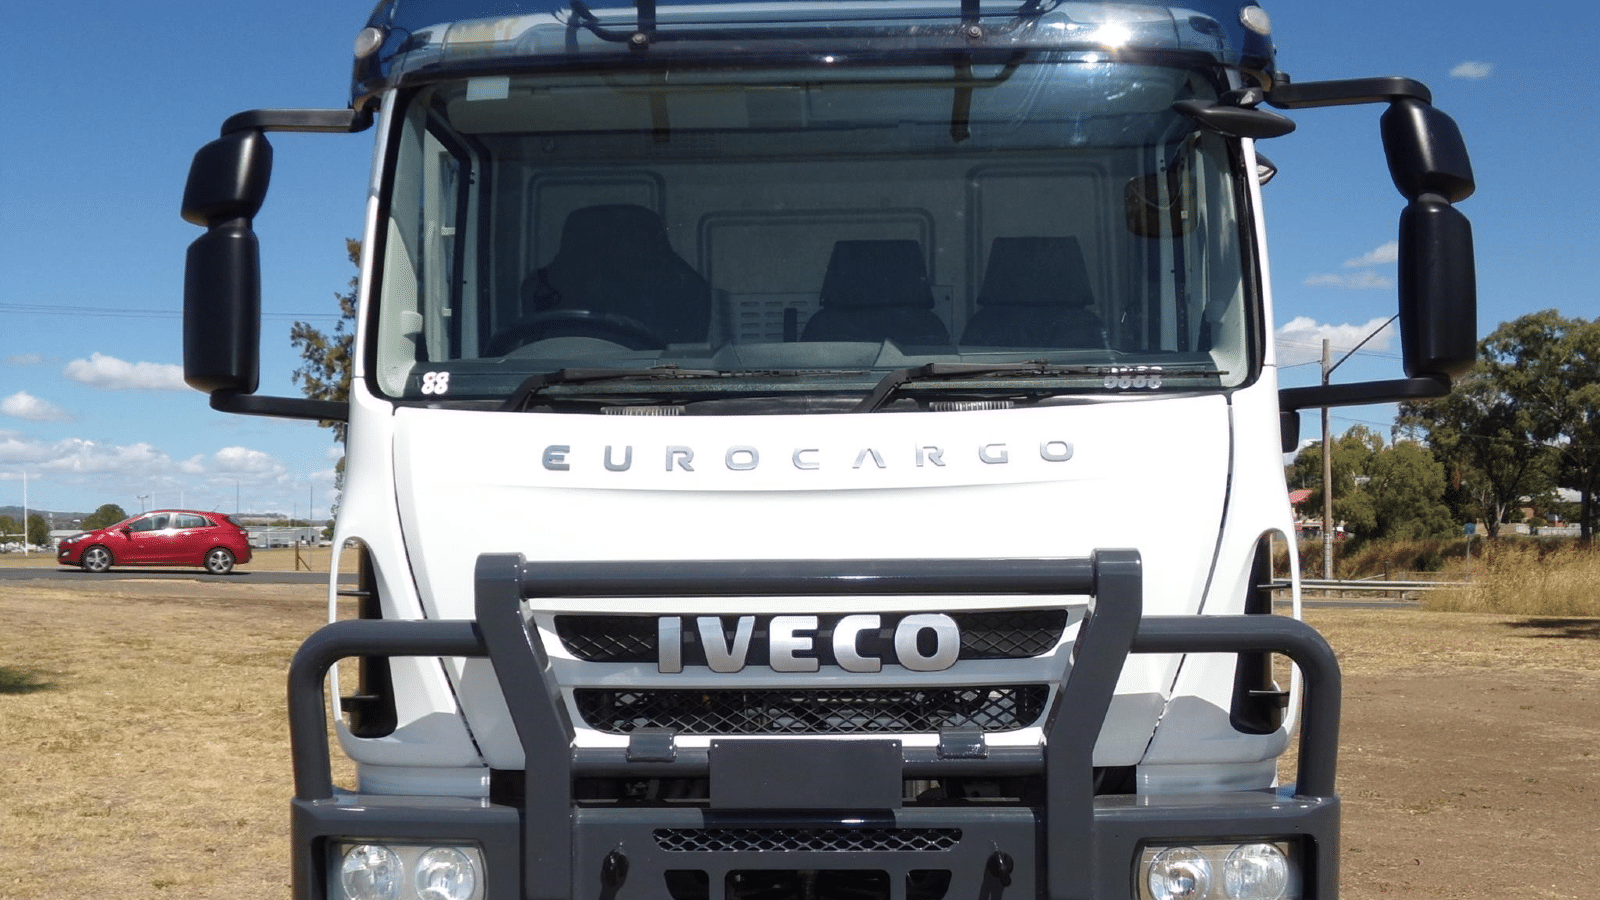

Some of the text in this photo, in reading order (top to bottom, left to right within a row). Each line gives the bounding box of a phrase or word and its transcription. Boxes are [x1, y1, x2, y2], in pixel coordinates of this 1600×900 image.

[421, 371, 449, 395] 88
[541, 440, 1074, 471] EUROCARGO
[657, 613, 961, 674] IVECO
